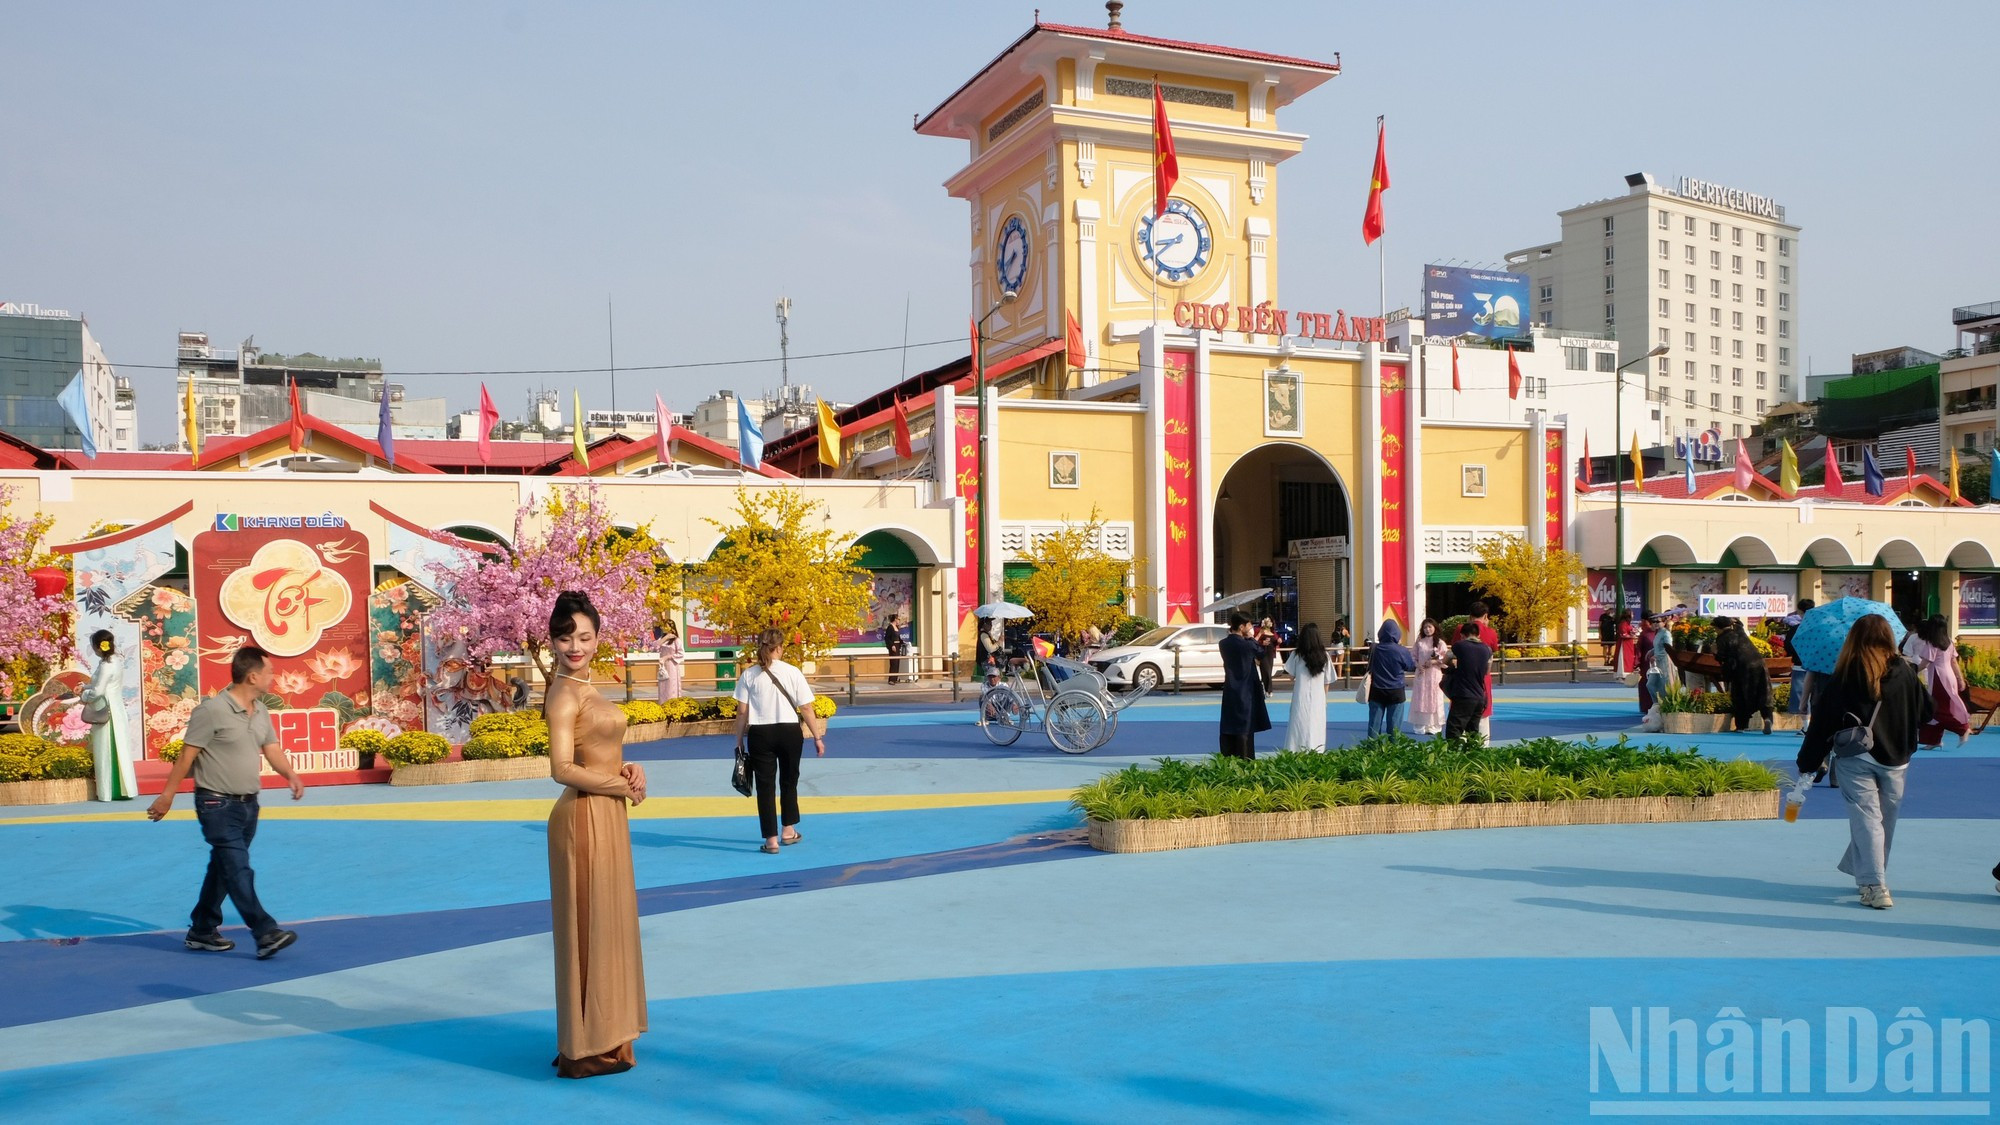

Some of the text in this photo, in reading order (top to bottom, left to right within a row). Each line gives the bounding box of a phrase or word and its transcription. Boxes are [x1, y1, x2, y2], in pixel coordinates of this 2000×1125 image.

[1681, 176, 1779, 219] LIBERTY CENTRAL
[40, 309, 70, 318] HOTEL
[1174, 301, 1230, 334] CHỢ
[1237, 300, 1288, 335] BẾN
[1296, 308, 1388, 343] THÀNH
[1453, 338, 1466, 348] AR
[1565, 338, 1589, 348] HOTEL
[243, 510, 345, 528] KHANG ĐIỀN
[1587, 577, 1617, 603] Vikk
[1716, 596, 1786, 613] KHANG ĐIỀN 2026
